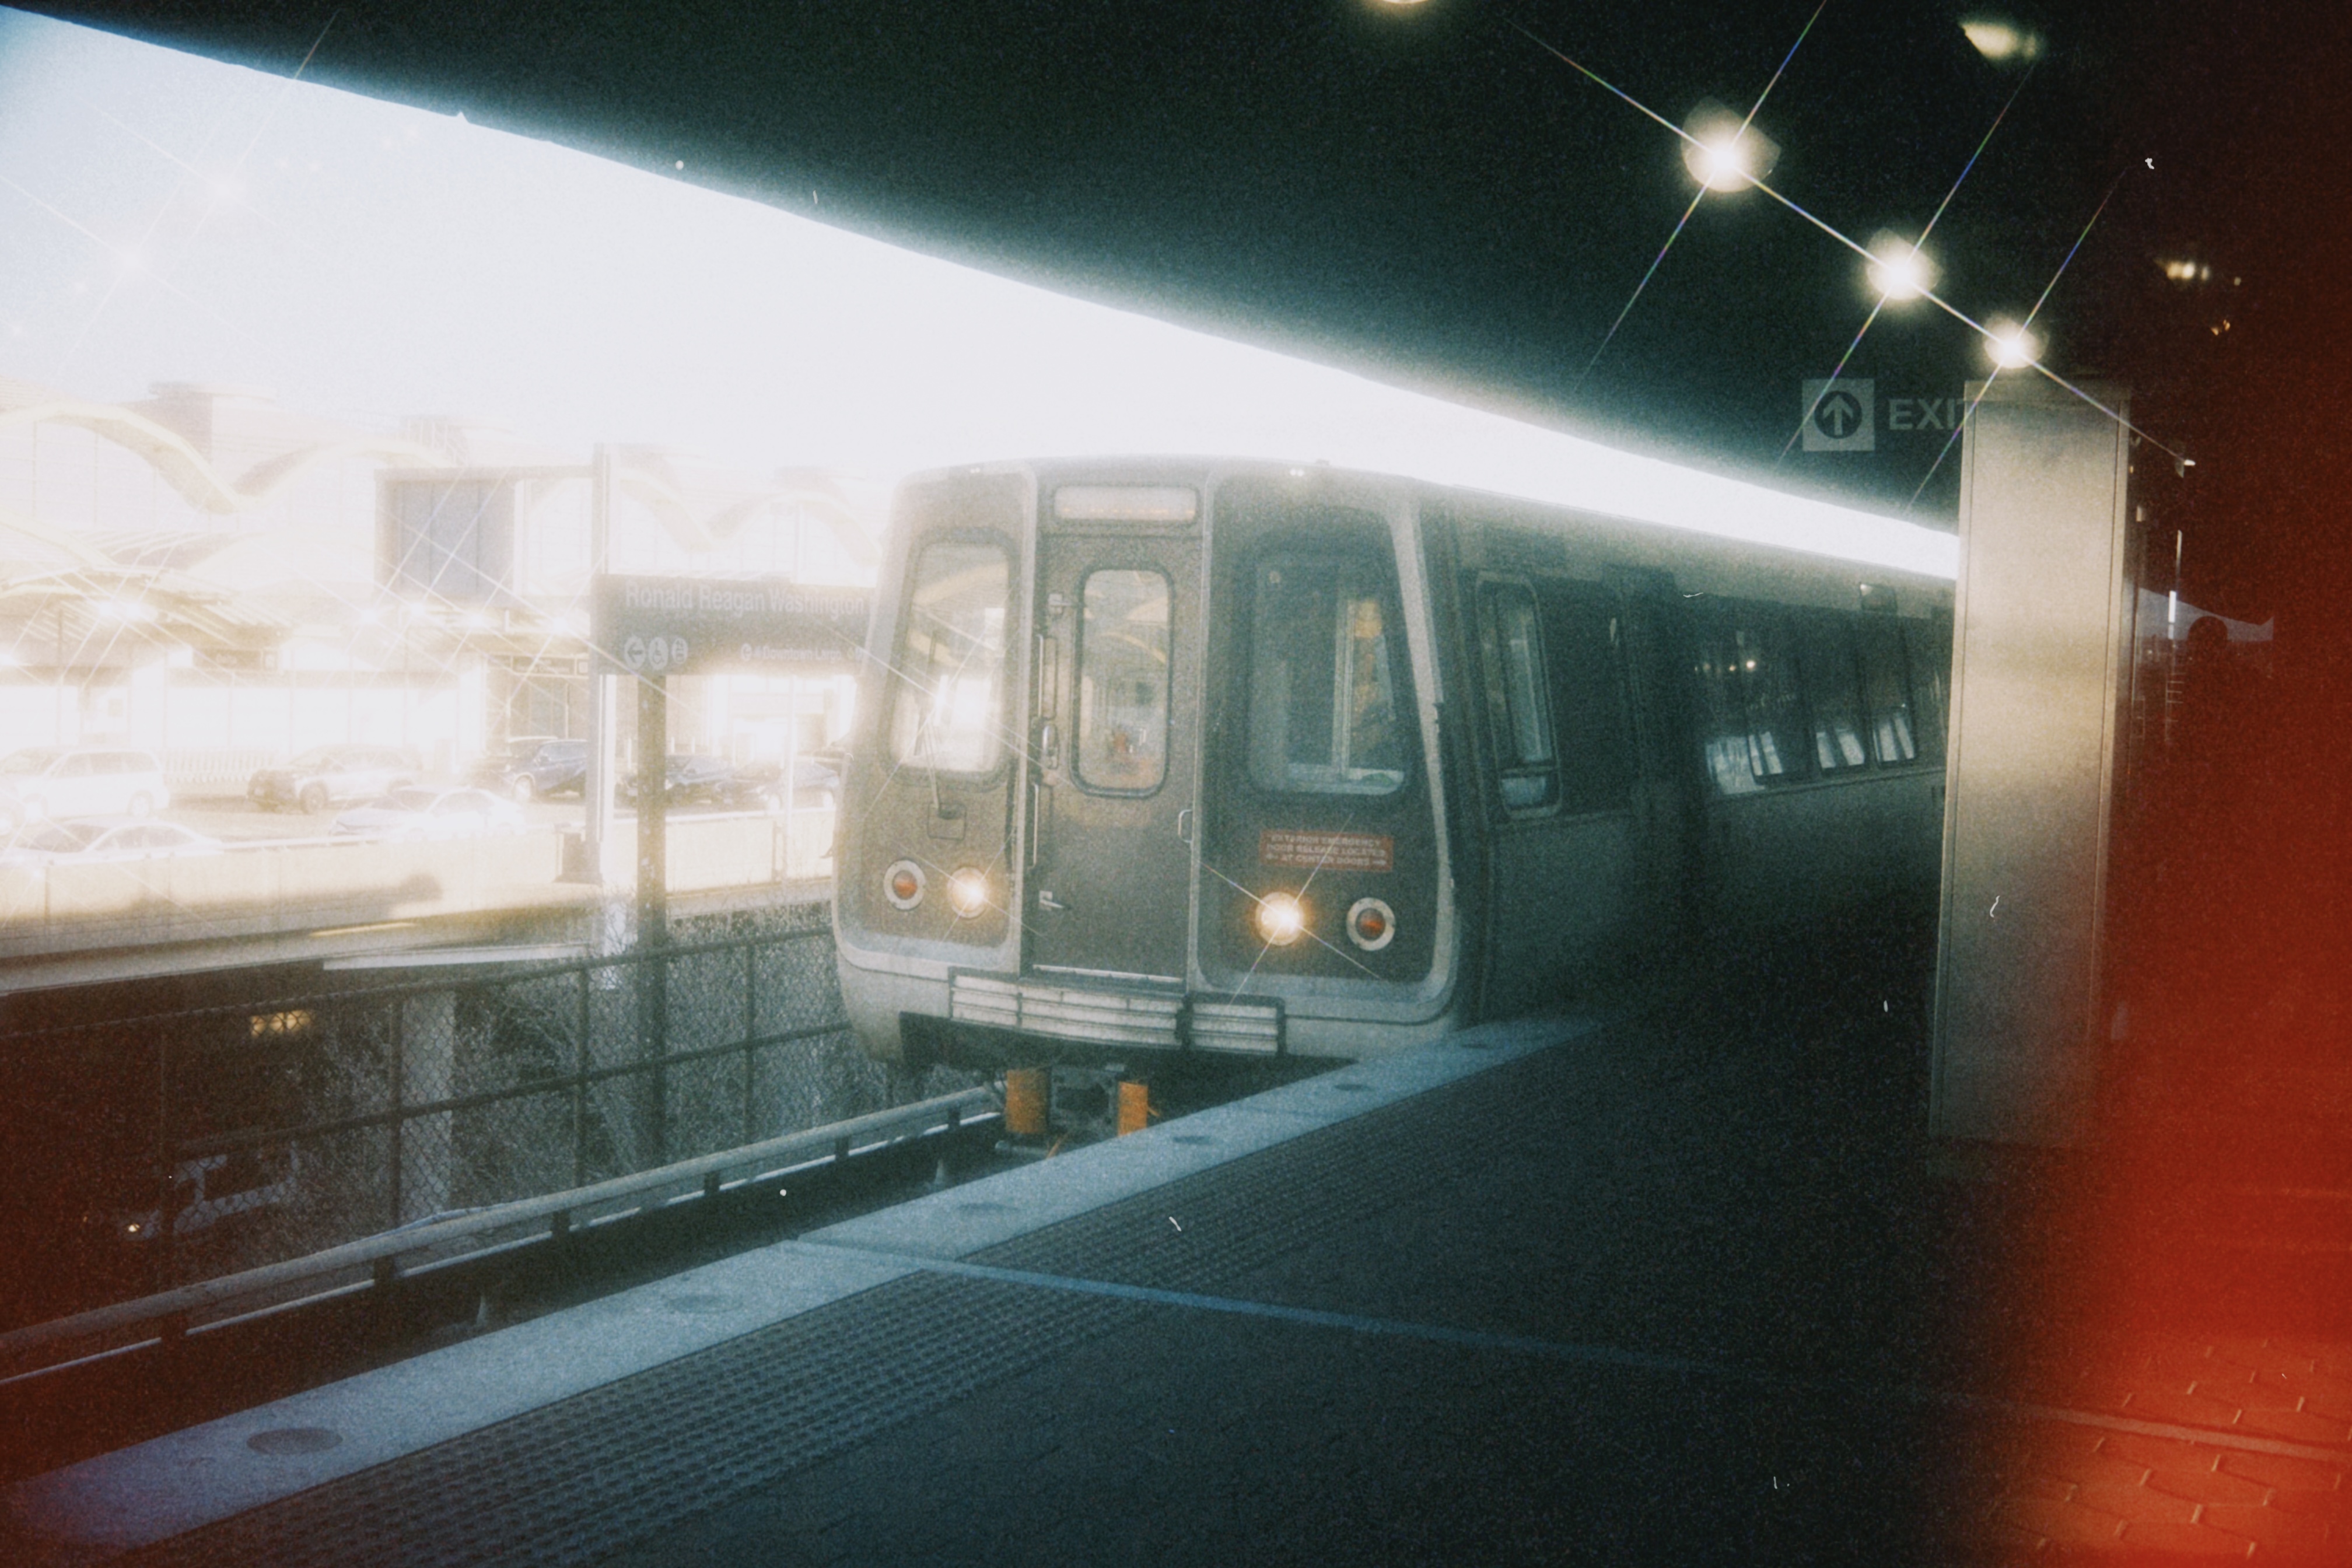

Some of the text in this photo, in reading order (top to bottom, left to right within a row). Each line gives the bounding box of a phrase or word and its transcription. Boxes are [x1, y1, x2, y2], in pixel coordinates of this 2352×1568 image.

[1889, 398, 1964, 430] EXI
[625, 579, 864, 621] Ronald Reagan Washington
[1271, 834, 1381, 846] EXTERIOR EMERGENCY
[1266, 844, 1386, 857] DOOR RELEASE LOCATED
[1282, 853, 1370, 866] AT CENTER DOORS
